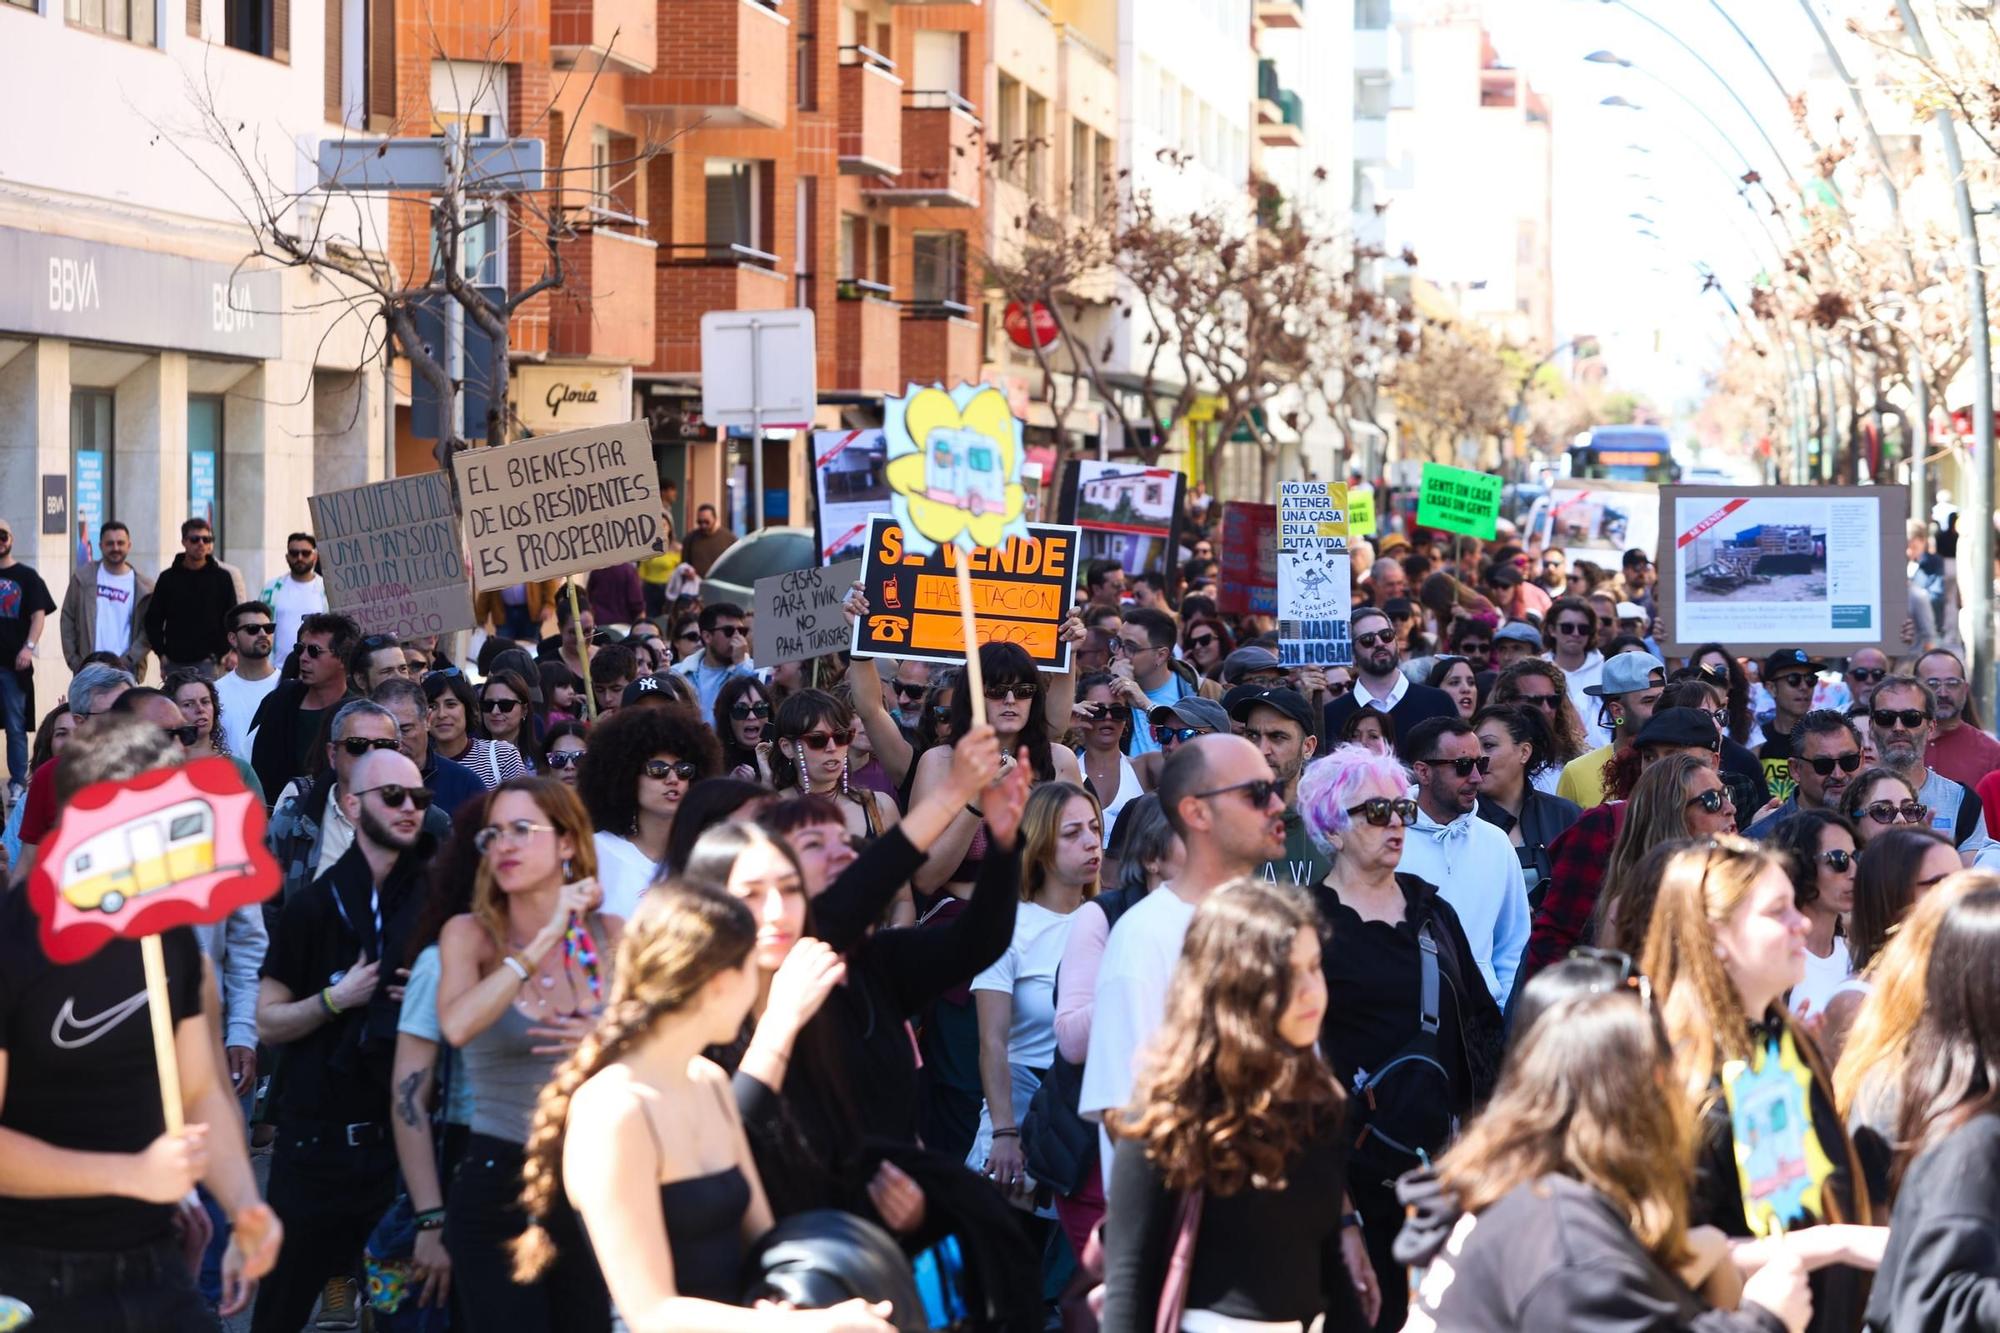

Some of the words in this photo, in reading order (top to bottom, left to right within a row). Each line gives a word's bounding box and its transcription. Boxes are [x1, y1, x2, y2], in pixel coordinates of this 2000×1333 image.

[49, 256, 100, 313] BBVA
[212, 282, 254, 332] BBVA
[546, 382, 599, 418] Gloria
[468, 465, 499, 495] EL
[507, 440, 627, 488] BIENESTAR
[1282, 484, 1300, 495] NO
[1302, 484, 1326, 494] VAS
[1282, 497, 1290, 508] A
[1292, 497, 1331, 508] TENER
[47, 495, 64, 514] BBVA
[318, 491, 352, 540] NO
[353, 474, 453, 533] QUEREMOS
[1282, 511, 1307, 521] UNA
[1309, 510, 1342, 521] CASA
[470, 507, 498, 538] DE
[499, 501, 532, 530] LOS
[1282, 524, 1298, 535] EN
[1300, 524, 1316, 535] LA
[328, 538, 364, 566] UNA
[879, 526, 925, 566] S
[1283, 537, 1313, 548] PUTA
[1315, 537, 1346, 548] VIDA.
[334, 563, 370, 592] SOLO
[375, 559, 399, 585] UN
[404, 551, 459, 584] TECHO
[479, 546, 508, 577] ES
[781, 568, 822, 593] CASAS
[399, 601, 418, 617] NO
[772, 593, 807, 618] PARA
[796, 614, 816, 633] NO
[1301, 620, 1346, 640] NADIE
[775, 636, 804, 656] PARA
[806, 626, 850, 650] TURISTAS
